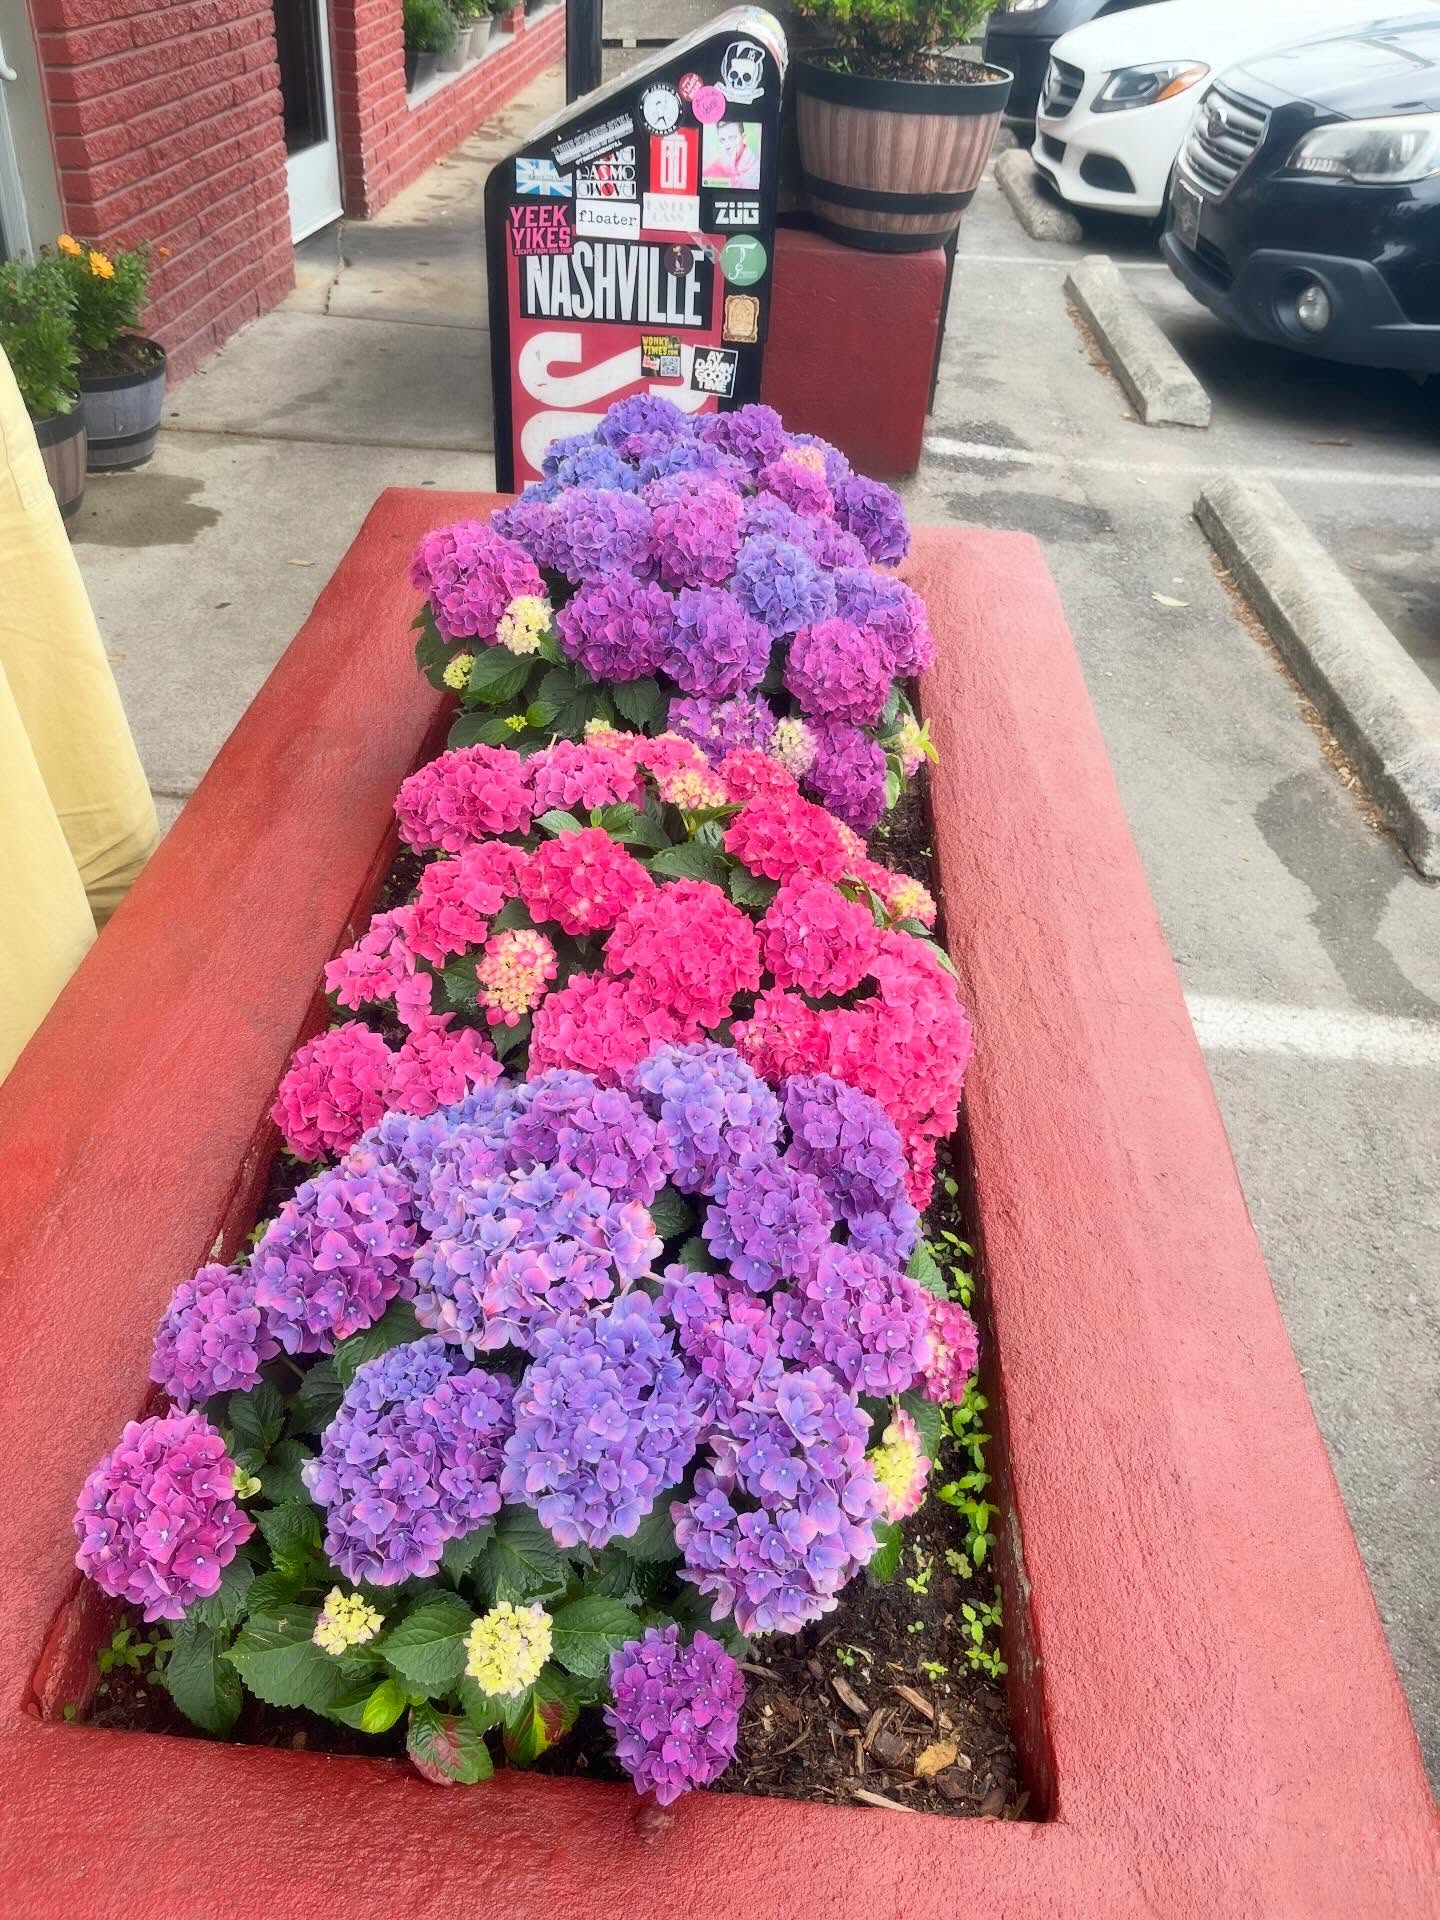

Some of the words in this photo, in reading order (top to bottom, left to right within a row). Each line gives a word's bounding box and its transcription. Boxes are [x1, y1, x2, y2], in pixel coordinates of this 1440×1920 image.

[510, 205, 568, 227] YEEK
[579, 210, 636, 226] floater
[512, 227, 571, 249] YIKES
[526, 241, 704, 326] NASHVILLE
[642, 336, 669, 346] WONKY
[707, 351, 724, 362] AY
[695, 359, 734, 374] DAMN
[695, 369, 732, 384] GOOD
[700, 380, 726, 393] TIME
